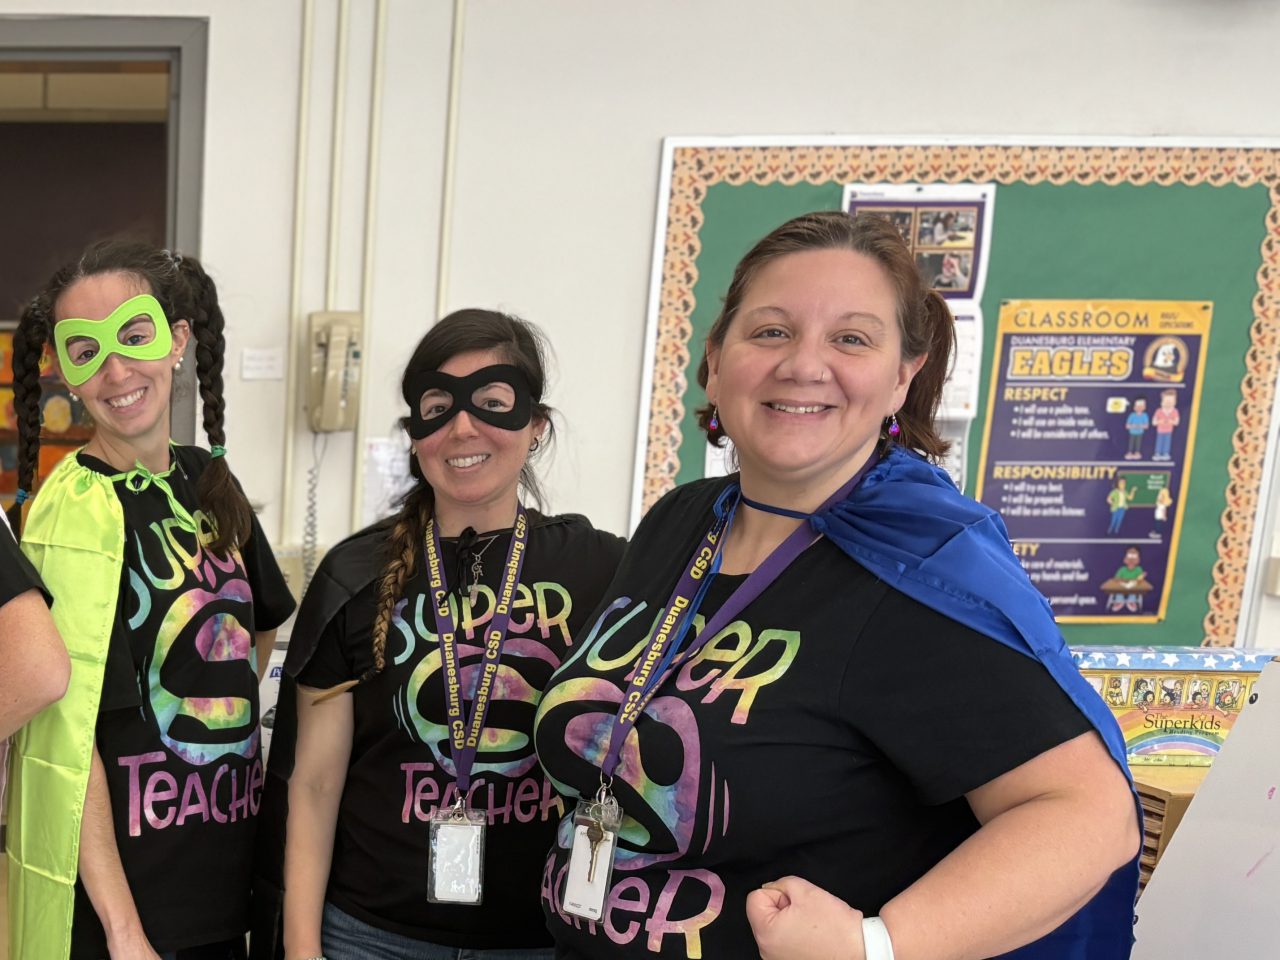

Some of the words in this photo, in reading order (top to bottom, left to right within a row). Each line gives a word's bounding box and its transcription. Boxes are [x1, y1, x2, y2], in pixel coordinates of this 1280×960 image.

[1013, 311, 1150, 328] CLASSROOM
[1010, 336, 1075, 347] DUANESBURG
[1077, 336, 1137, 347] ELEMENTARY
[1009, 348, 1133, 379] EAGLES
[1004, 388, 1068, 401] RESPECT
[993, 466, 1117, 479] RESPONSIBILITY
[1013, 543, 1040, 556] ETY
[496, 541, 525, 615] Duanesburg
[515, 514, 527, 538] CSD
[690, 546, 712, 580] CSD
[632, 595, 689, 687] Duanesburg
[443, 633, 460, 717] Duanesburg
[452, 720, 465, 749] CSD
[466, 663, 496, 747] Duanesburg
[486, 630, 502, 659] CSD
[1144, 713, 1221, 732] Superkids
